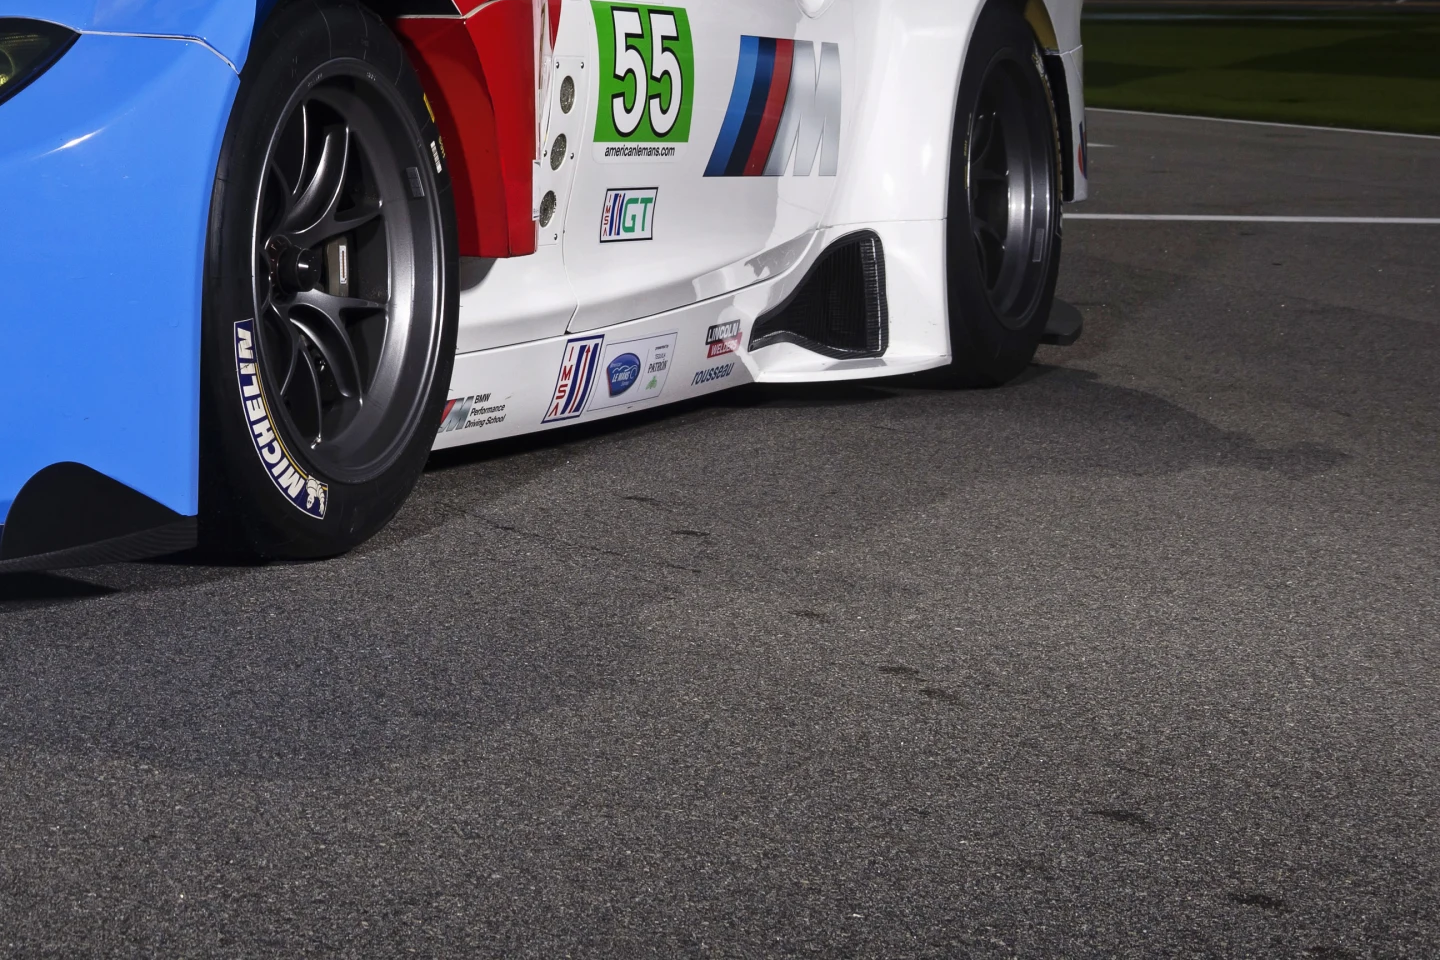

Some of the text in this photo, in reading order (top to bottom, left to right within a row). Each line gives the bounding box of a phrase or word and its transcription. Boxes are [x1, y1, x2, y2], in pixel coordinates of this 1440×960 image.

[610, 5, 683, 138] 55
[605, 144, 676, 157] americanlemans.com
[622, 197, 654, 234] GT
[707, 322, 739, 343] LINCOLN
[710, 339, 739, 356] WELDERS
[548, 346, 575, 417] IMSA
[691, 362, 735, 387] rousseau
[474, 392, 491, 404] BMW
[237, 327, 306, 500] MICHELIN
[469, 404, 506, 417] Performance
[464, 414, 507, 429] Driving School
